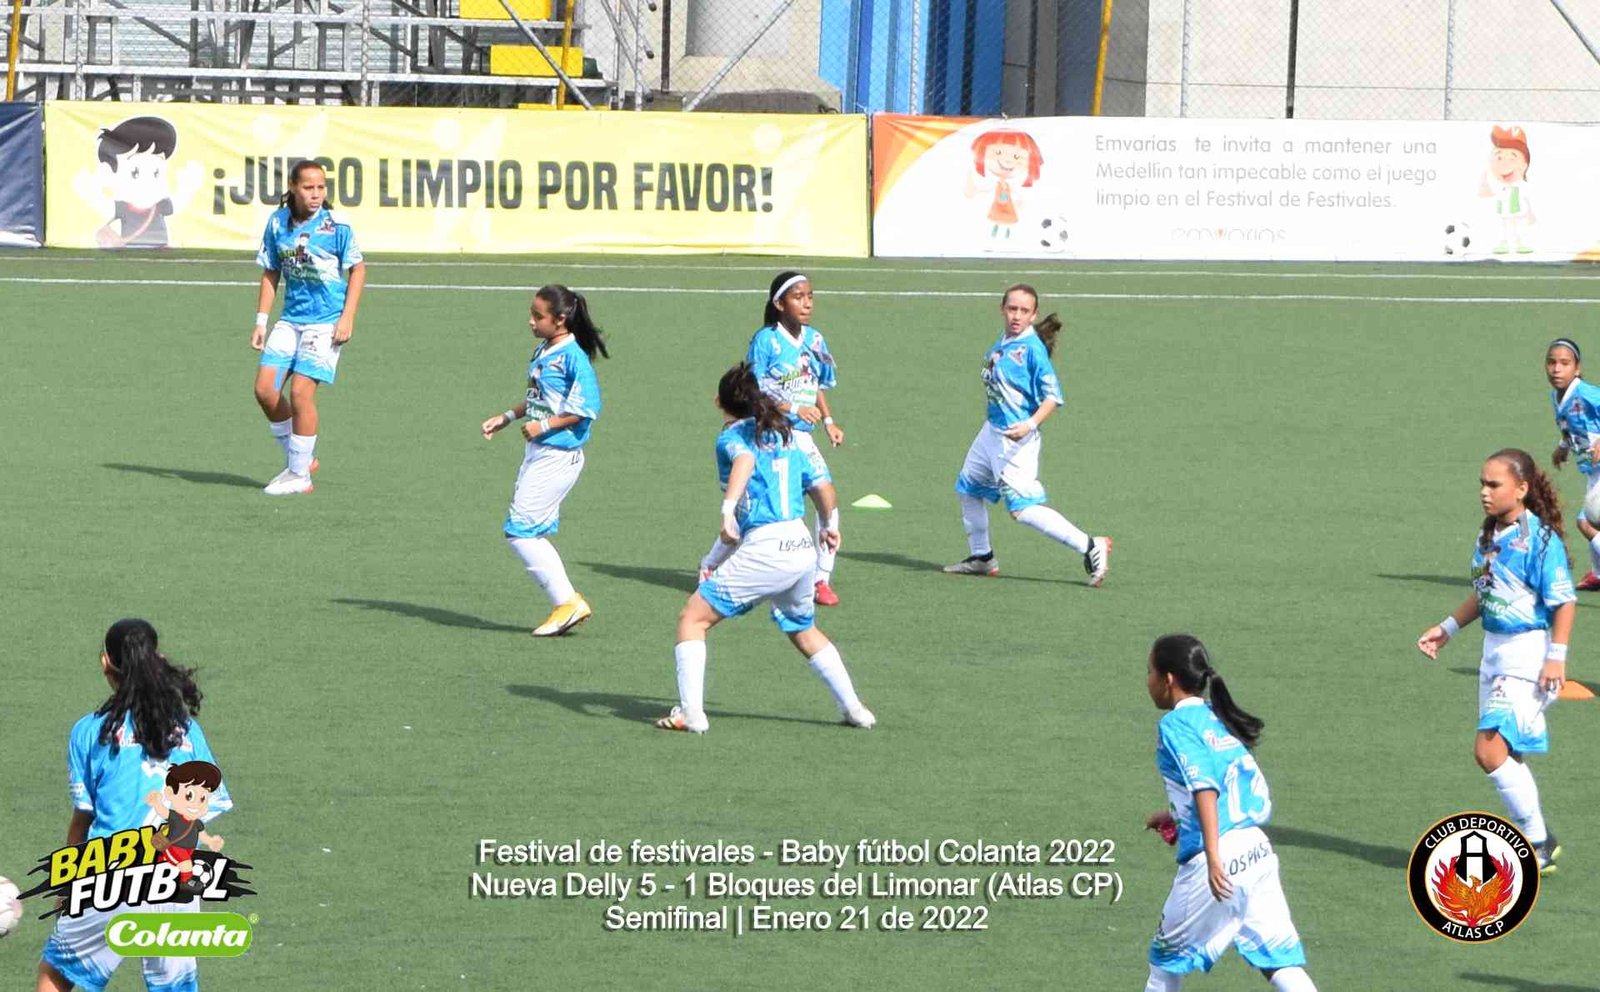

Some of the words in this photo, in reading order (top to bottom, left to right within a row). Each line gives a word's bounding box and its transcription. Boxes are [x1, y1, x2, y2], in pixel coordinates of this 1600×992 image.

[1195, 136, 1212, 153] te
[1223, 135, 1272, 153] invita
[1282, 141, 1294, 153] a
[1305, 137, 1392, 154] mantener
[1403, 141, 1437, 154] una
[379, 158, 522, 209] LIMPIO
[538, 160, 618, 211] POR
[633, 162, 773, 213] FAVOR!
[1178, 164, 1207, 180] tan
[1213, 162, 1307, 184] impecable
[1312, 167, 1361, 181] como
[1366, 164, 1382, 181] el
[1386, 164, 1437, 186] juego
[1096, 188, 1150, 211] limpio
[1156, 193, 1179, 207] en
[1185, 190, 1200, 207] el
[1207, 190, 1273, 207] Festival
[1279, 190, 1301, 207] de
[772, 458, 790, 520] 1
